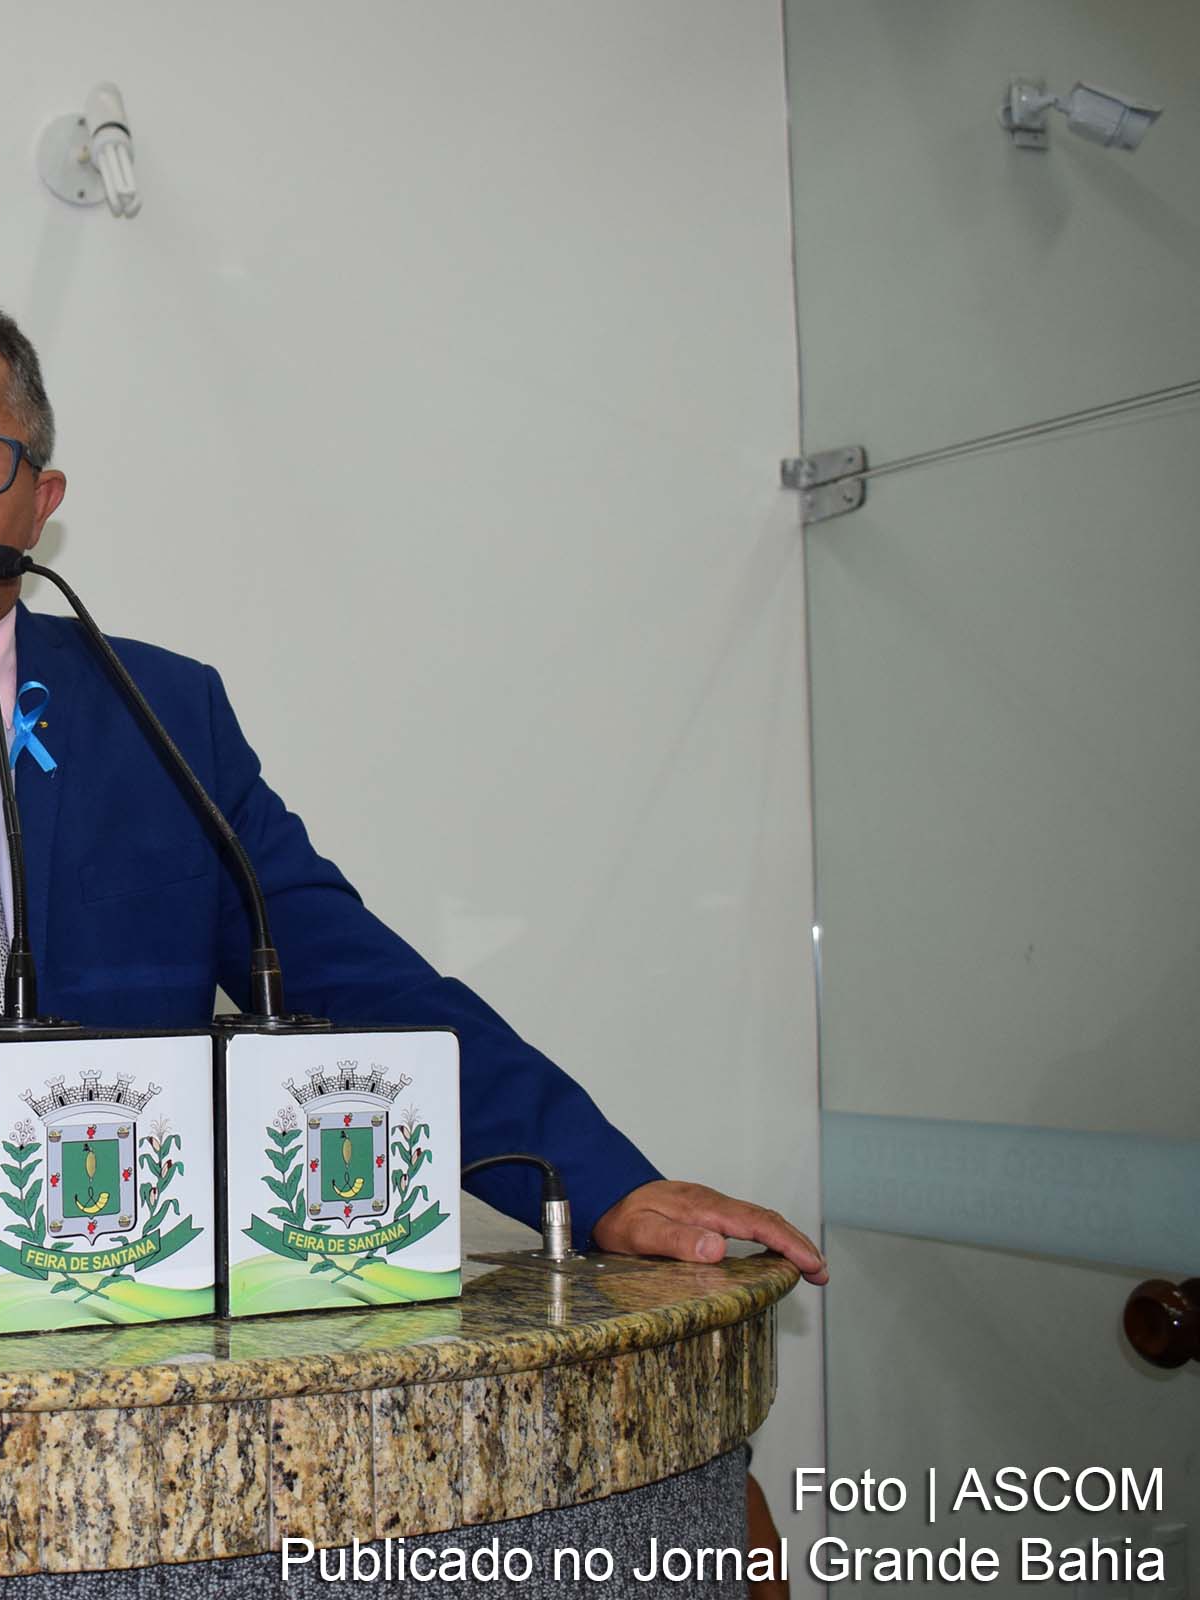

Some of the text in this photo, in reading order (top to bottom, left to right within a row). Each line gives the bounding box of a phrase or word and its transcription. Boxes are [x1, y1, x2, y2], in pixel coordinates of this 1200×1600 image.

[287, 1223, 406, 1252] FEIRA DE SANTANA
[26, 1238, 156, 1271] FEIRA DE SANTANA
